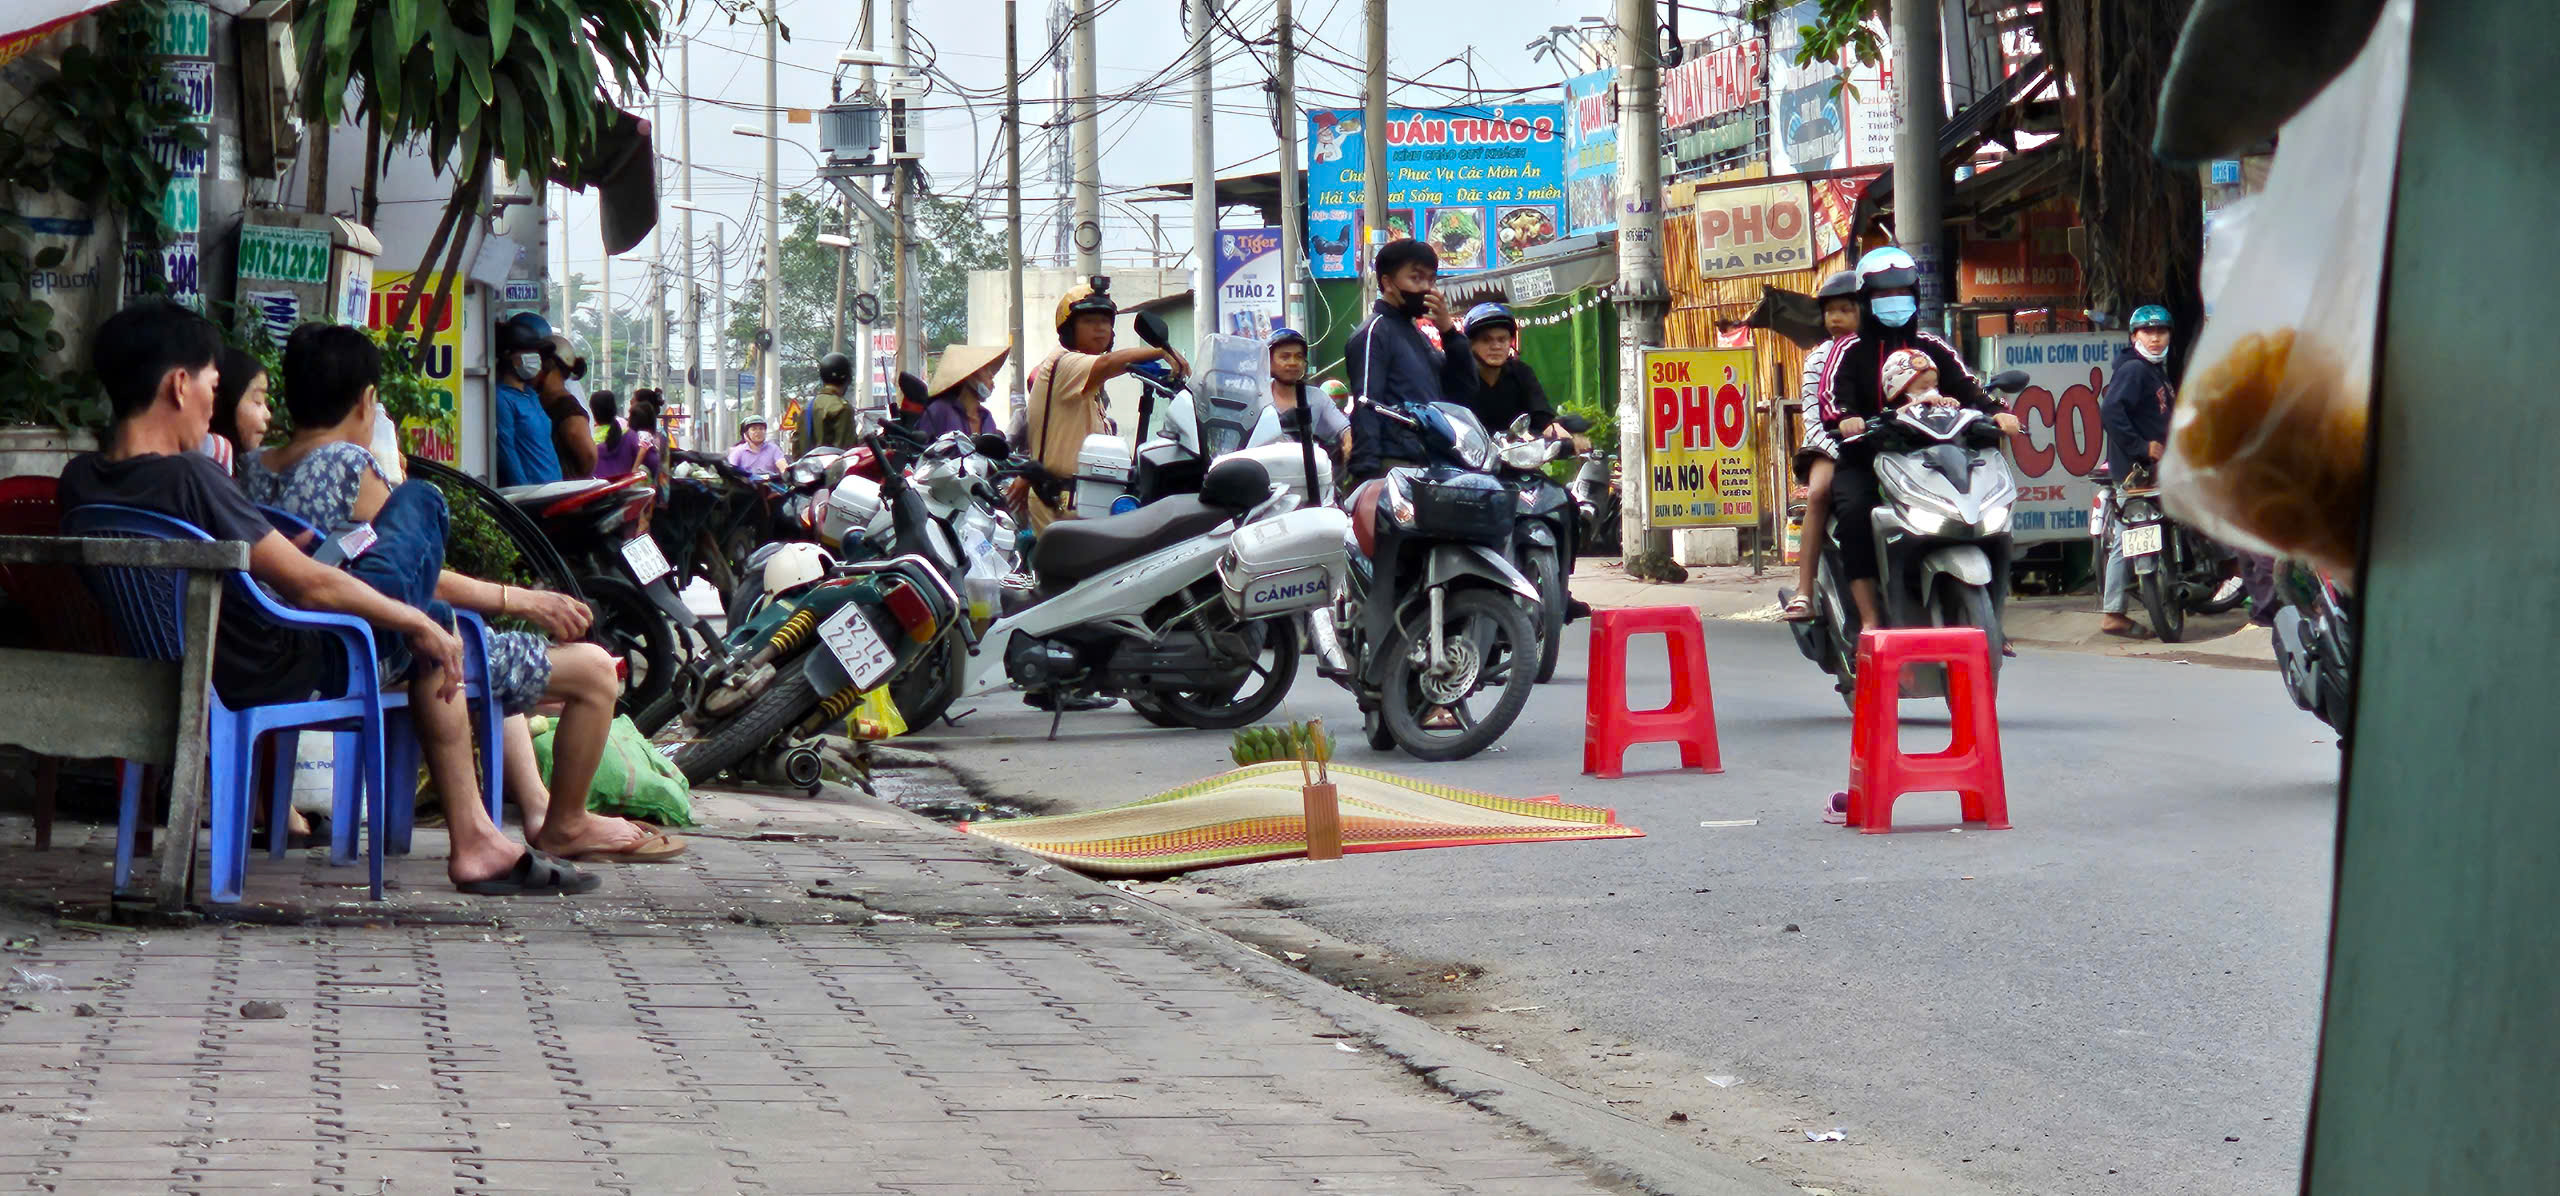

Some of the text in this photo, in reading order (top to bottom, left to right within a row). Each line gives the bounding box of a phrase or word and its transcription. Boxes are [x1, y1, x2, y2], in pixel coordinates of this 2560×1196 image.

[1750, 40, 1761, 101] 2
[1387, 110, 1553, 144] UÁN THẢO 2
[1398, 167, 1432, 183] Phục
[1436, 167, 1454, 181] Vụ
[1458, 166, 1484, 179] Các
[1487, 165, 1518, 179] Món
[1521, 160, 1541, 178] Ăn
[1347, 188, 1365, 204] Sả
[1409, 187, 1442, 204] Sống
[1515, 187, 1524, 200] 3
[1528, 183, 1562, 199] miền
[1700, 185, 1803, 249] PHỞ
[1238, 234, 1277, 254] Tiger
[1705, 247, 1806, 271] HÀ NỘI
[1226, 280, 1275, 298] THẢO 2
[2006, 342, 2043, 364] QUÁN
[2047, 344, 2079, 363] CƠM
[2083, 340, 2109, 363] QUÊ
[1652, 361, 1691, 383] 30K
[1653, 365, 1748, 450] PHỞ
[2010, 367, 2110, 478] CƠ
[1654, 459, 1704, 497] HÀ NỘI
[2017, 484, 2066, 502] 25K
[2013, 506, 2088, 530] CƠM THÊM
[1254, 575, 1327, 603] CẢNH SÁ
[827, 626, 871, 678] 2226
